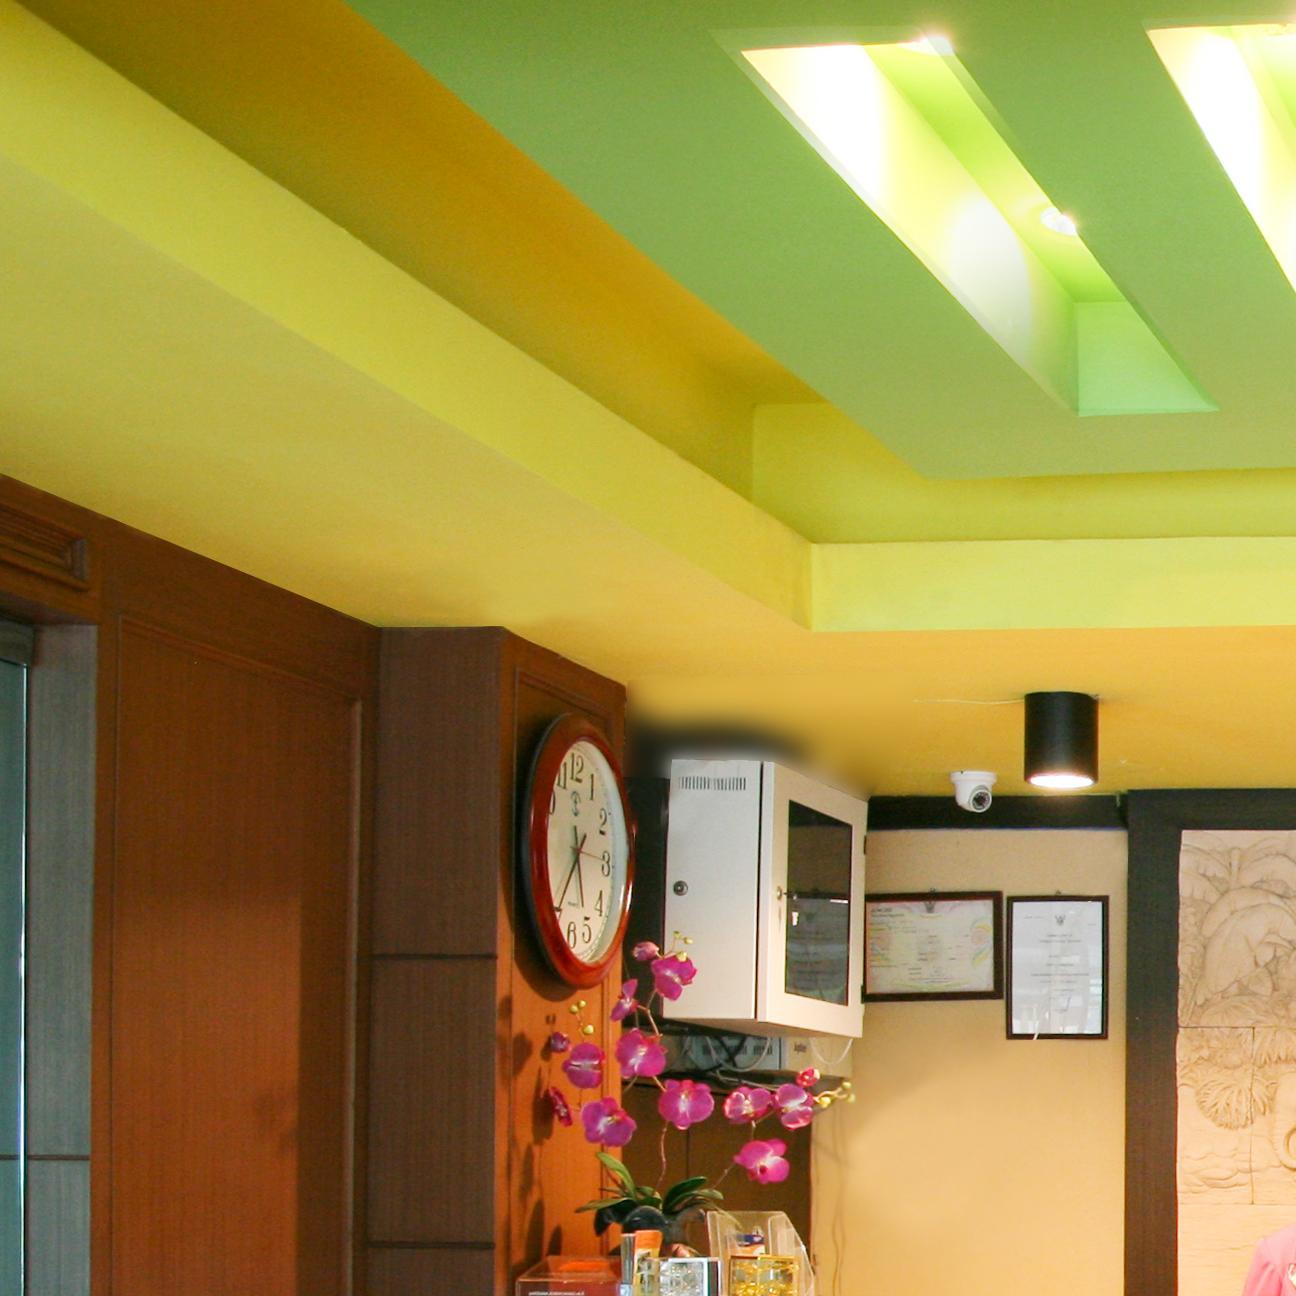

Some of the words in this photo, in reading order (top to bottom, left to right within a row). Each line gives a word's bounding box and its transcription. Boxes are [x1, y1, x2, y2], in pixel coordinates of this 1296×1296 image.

[570, 752, 584, 783] 12
[589, 773, 595, 801] 1
[599, 808, 608, 836] 2
[601, 851, 611, 877] 3
[594, 890, 603, 917] 4
[567, 921, 577, 948] 6
[582, 916, 592, 943] 5
